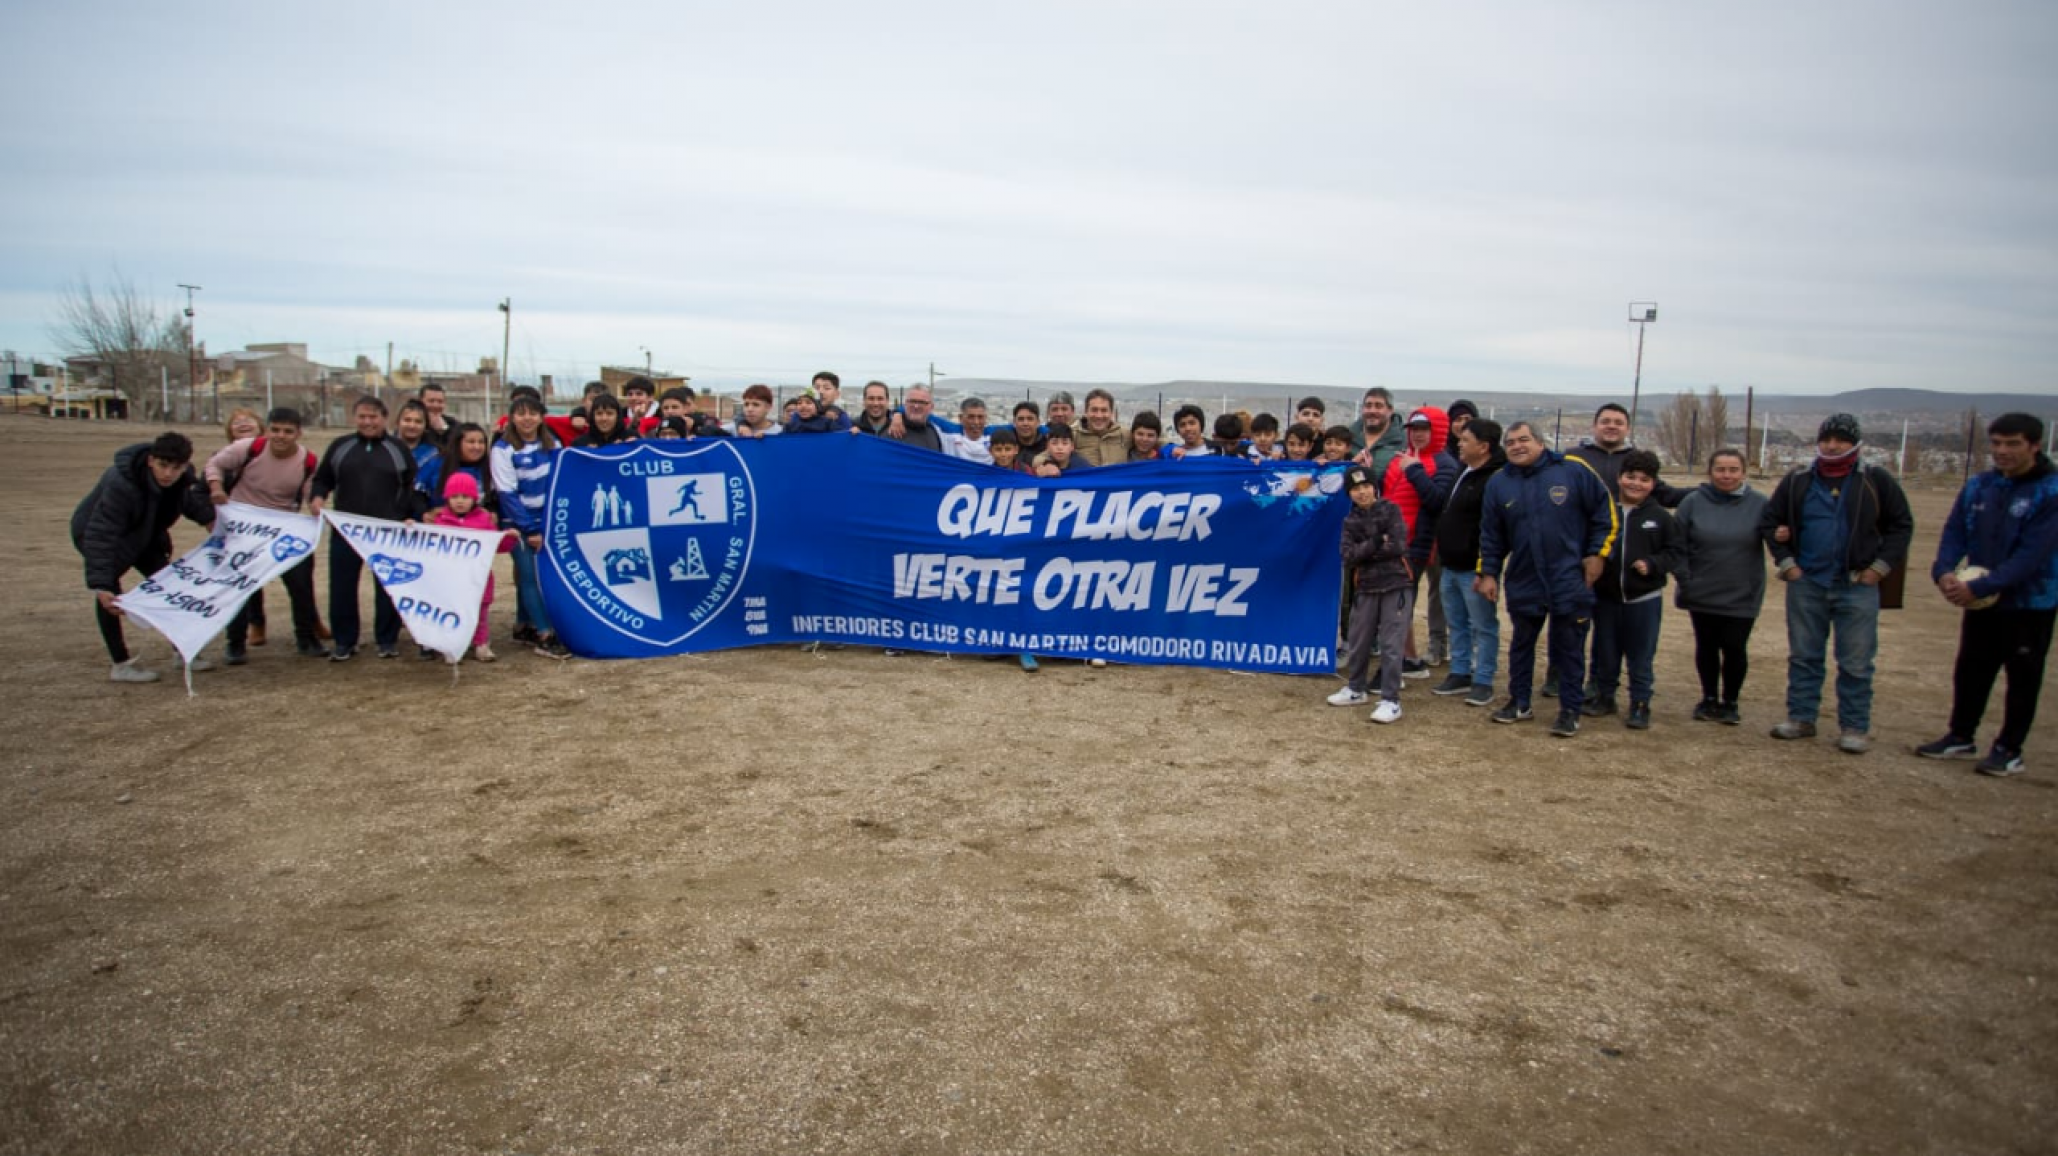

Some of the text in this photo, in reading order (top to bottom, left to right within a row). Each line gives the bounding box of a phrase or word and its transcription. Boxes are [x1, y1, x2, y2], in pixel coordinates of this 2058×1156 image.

[619, 460, 674, 476] CLUB
[937, 483, 1222, 542] QUE PLACER
[340, 522, 482, 557] SENTIMIENTO
[554, 498, 644, 629] SOCIAL DEPORTIVO
[723, 537, 743, 570] SAN
[688, 572, 732, 622] MARTIN
[893, 553, 1260, 616] VERTE OTRA VEZ
[792, 615, 1329, 666] INFERIORES CLUB SAN MARTIN COMODORO RIVADAVIA
